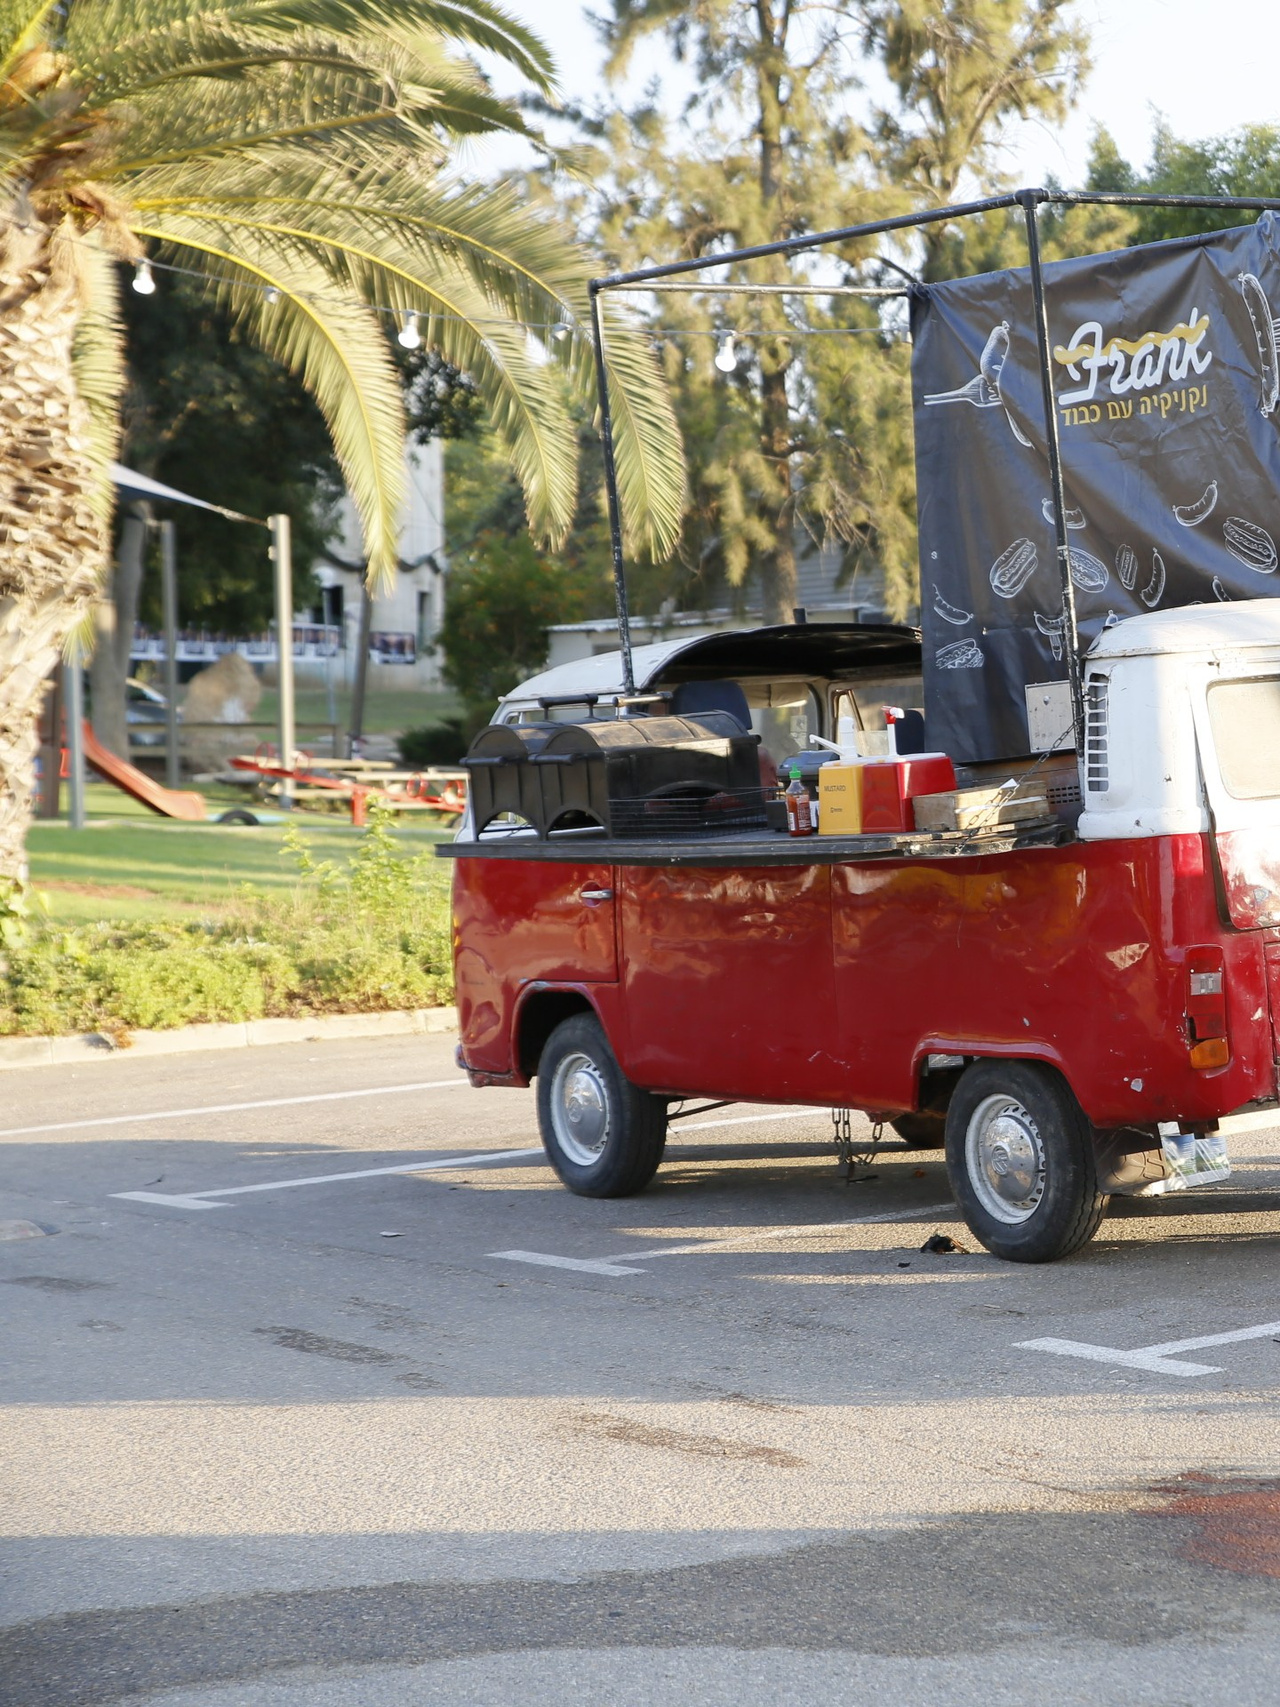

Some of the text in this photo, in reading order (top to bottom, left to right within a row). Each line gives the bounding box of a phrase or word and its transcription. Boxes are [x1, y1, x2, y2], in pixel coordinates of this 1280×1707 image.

[1058, 306, 1212, 406] Frank
[1060, 384, 1208, 426] נקניקיה עם כבוד
